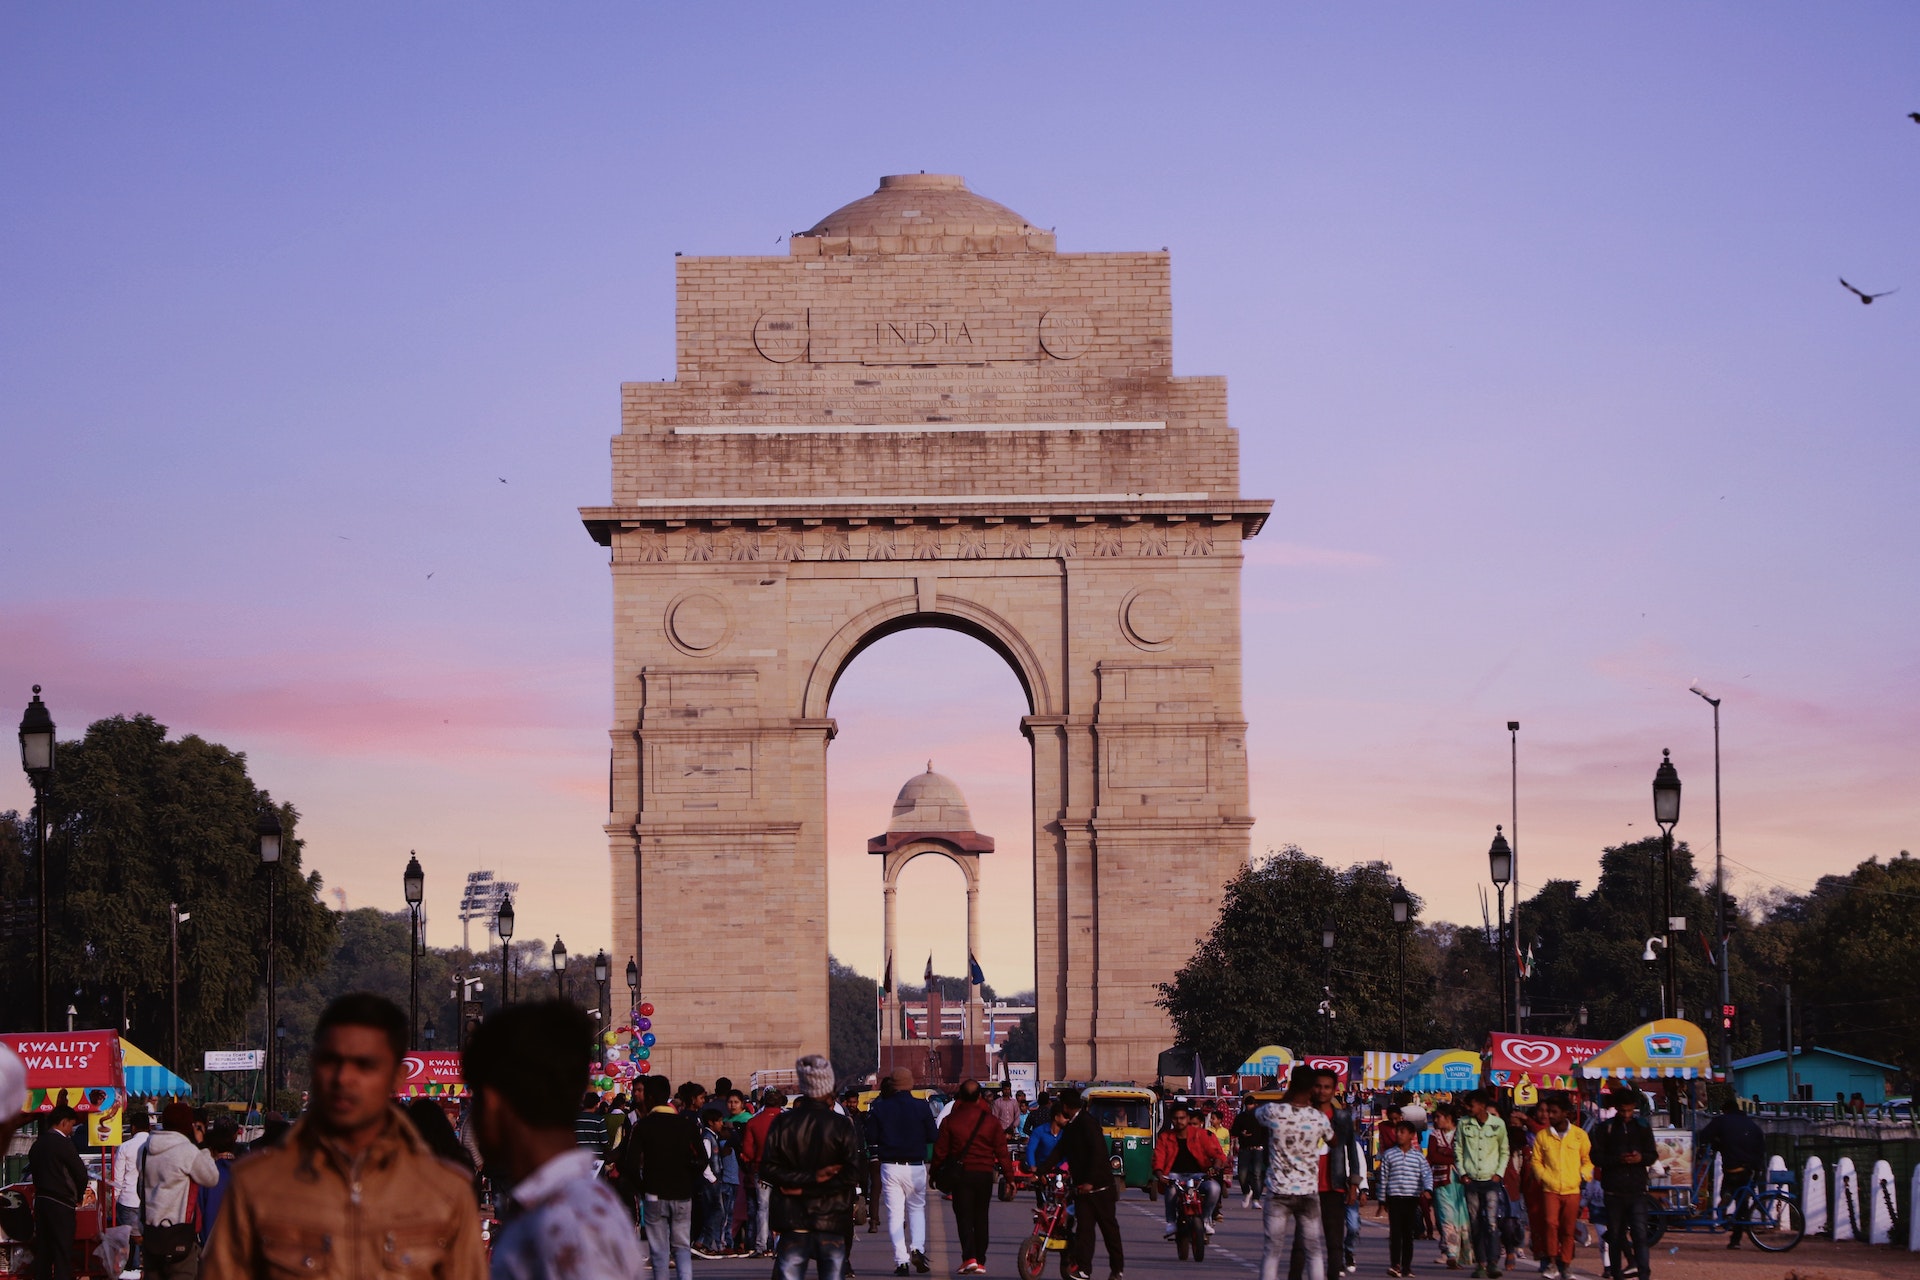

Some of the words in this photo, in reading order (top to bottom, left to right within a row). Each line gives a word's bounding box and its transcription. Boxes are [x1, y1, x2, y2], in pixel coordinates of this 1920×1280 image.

[876, 320, 974, 345] INDIA
[17, 1041, 101, 1054] KWALITY
[1566, 1046, 1602, 1055] KWAL
[24, 1055, 89, 1070] WALL'S
[433, 1068, 460, 1076] WALL
[1446, 1065, 1472, 1073] MOTHER
[1126, 1140, 1138, 1150] CNG
